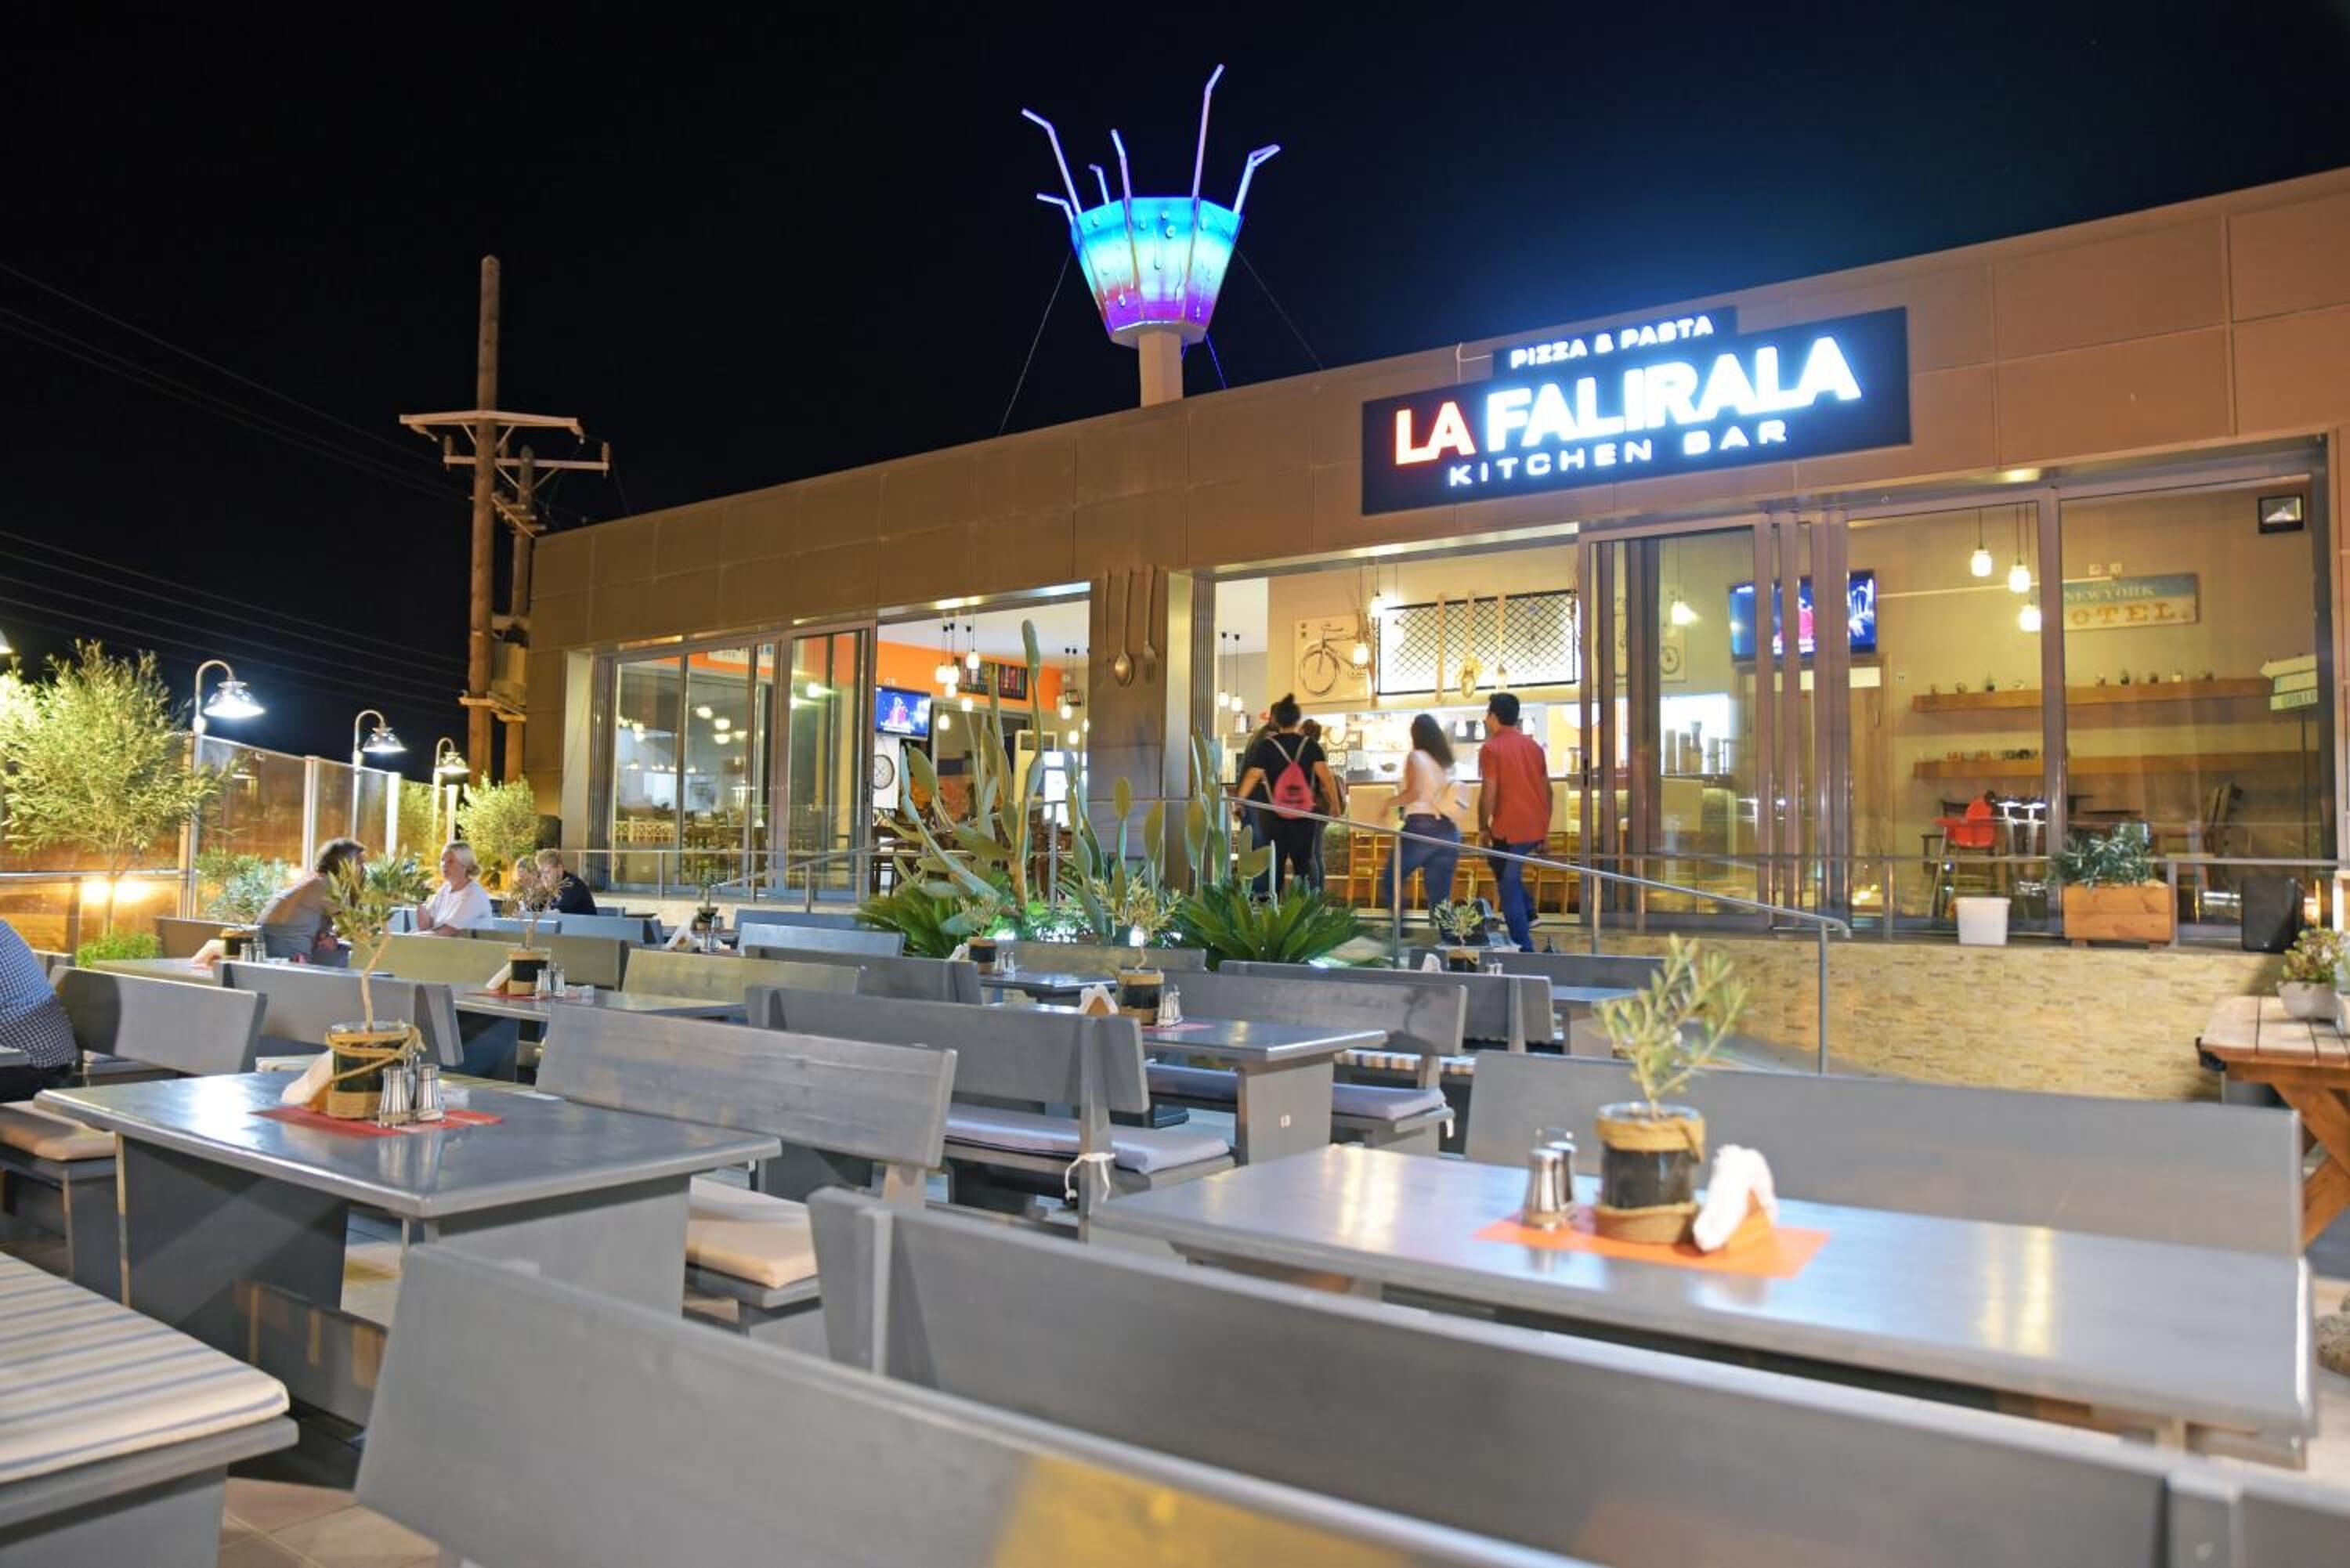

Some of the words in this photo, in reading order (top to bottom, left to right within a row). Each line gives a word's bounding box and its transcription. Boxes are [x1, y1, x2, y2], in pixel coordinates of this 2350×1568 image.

[1510, 338, 1588, 369] PIZZA
[1594, 333, 1614, 354] &
[1620, 316, 1714, 349] PASTA
[1395, 401, 1477, 464] LA
[1485, 336, 1862, 453] FALIRALA
[1449, 439, 1652, 486] KITCHEN
[1683, 419, 1787, 455] BAR
[2071, 602, 2175, 626] OTEL
